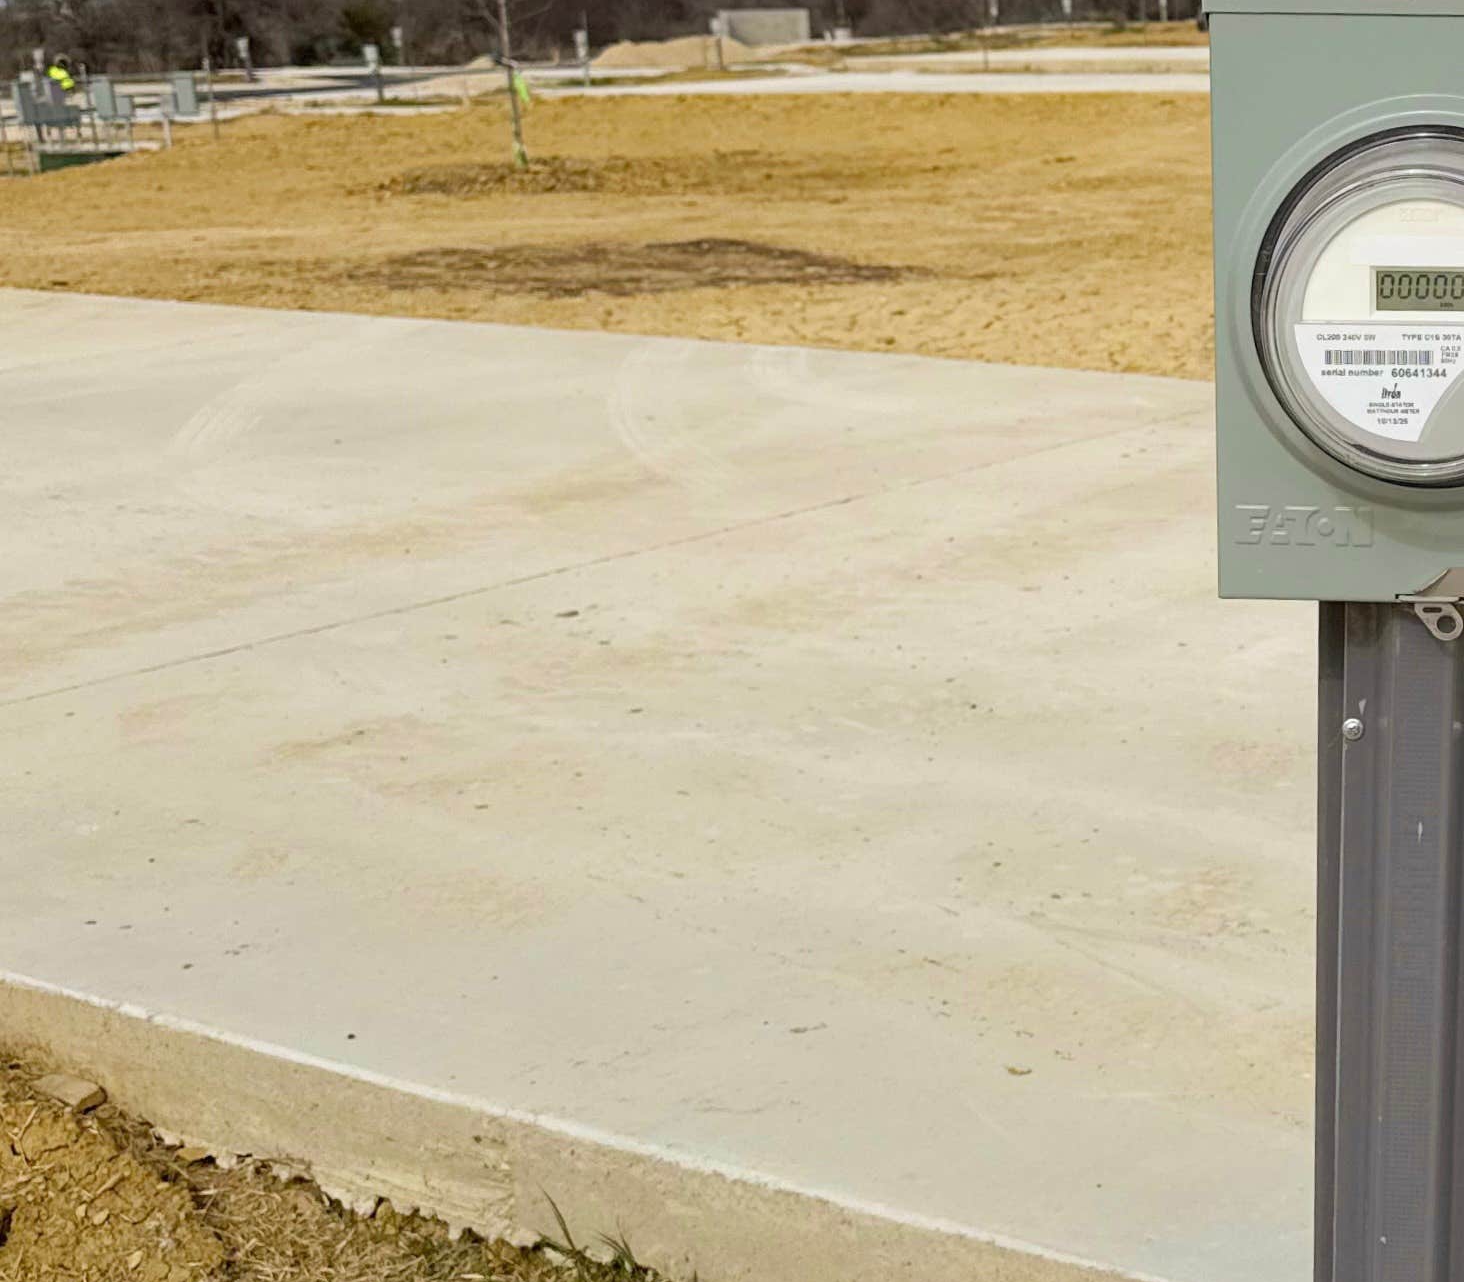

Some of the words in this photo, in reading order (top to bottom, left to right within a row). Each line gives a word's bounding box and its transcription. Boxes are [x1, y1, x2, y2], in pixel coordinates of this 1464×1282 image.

[1342, 333, 1362, 341] 240V
[1401, 333, 1422, 341] TYPE
[1321, 368, 1346, 376] serial
[1348, 368, 1384, 377] number
[1391, 368, 1447, 378] 60641344
[1235, 504, 1374, 548] EATON
